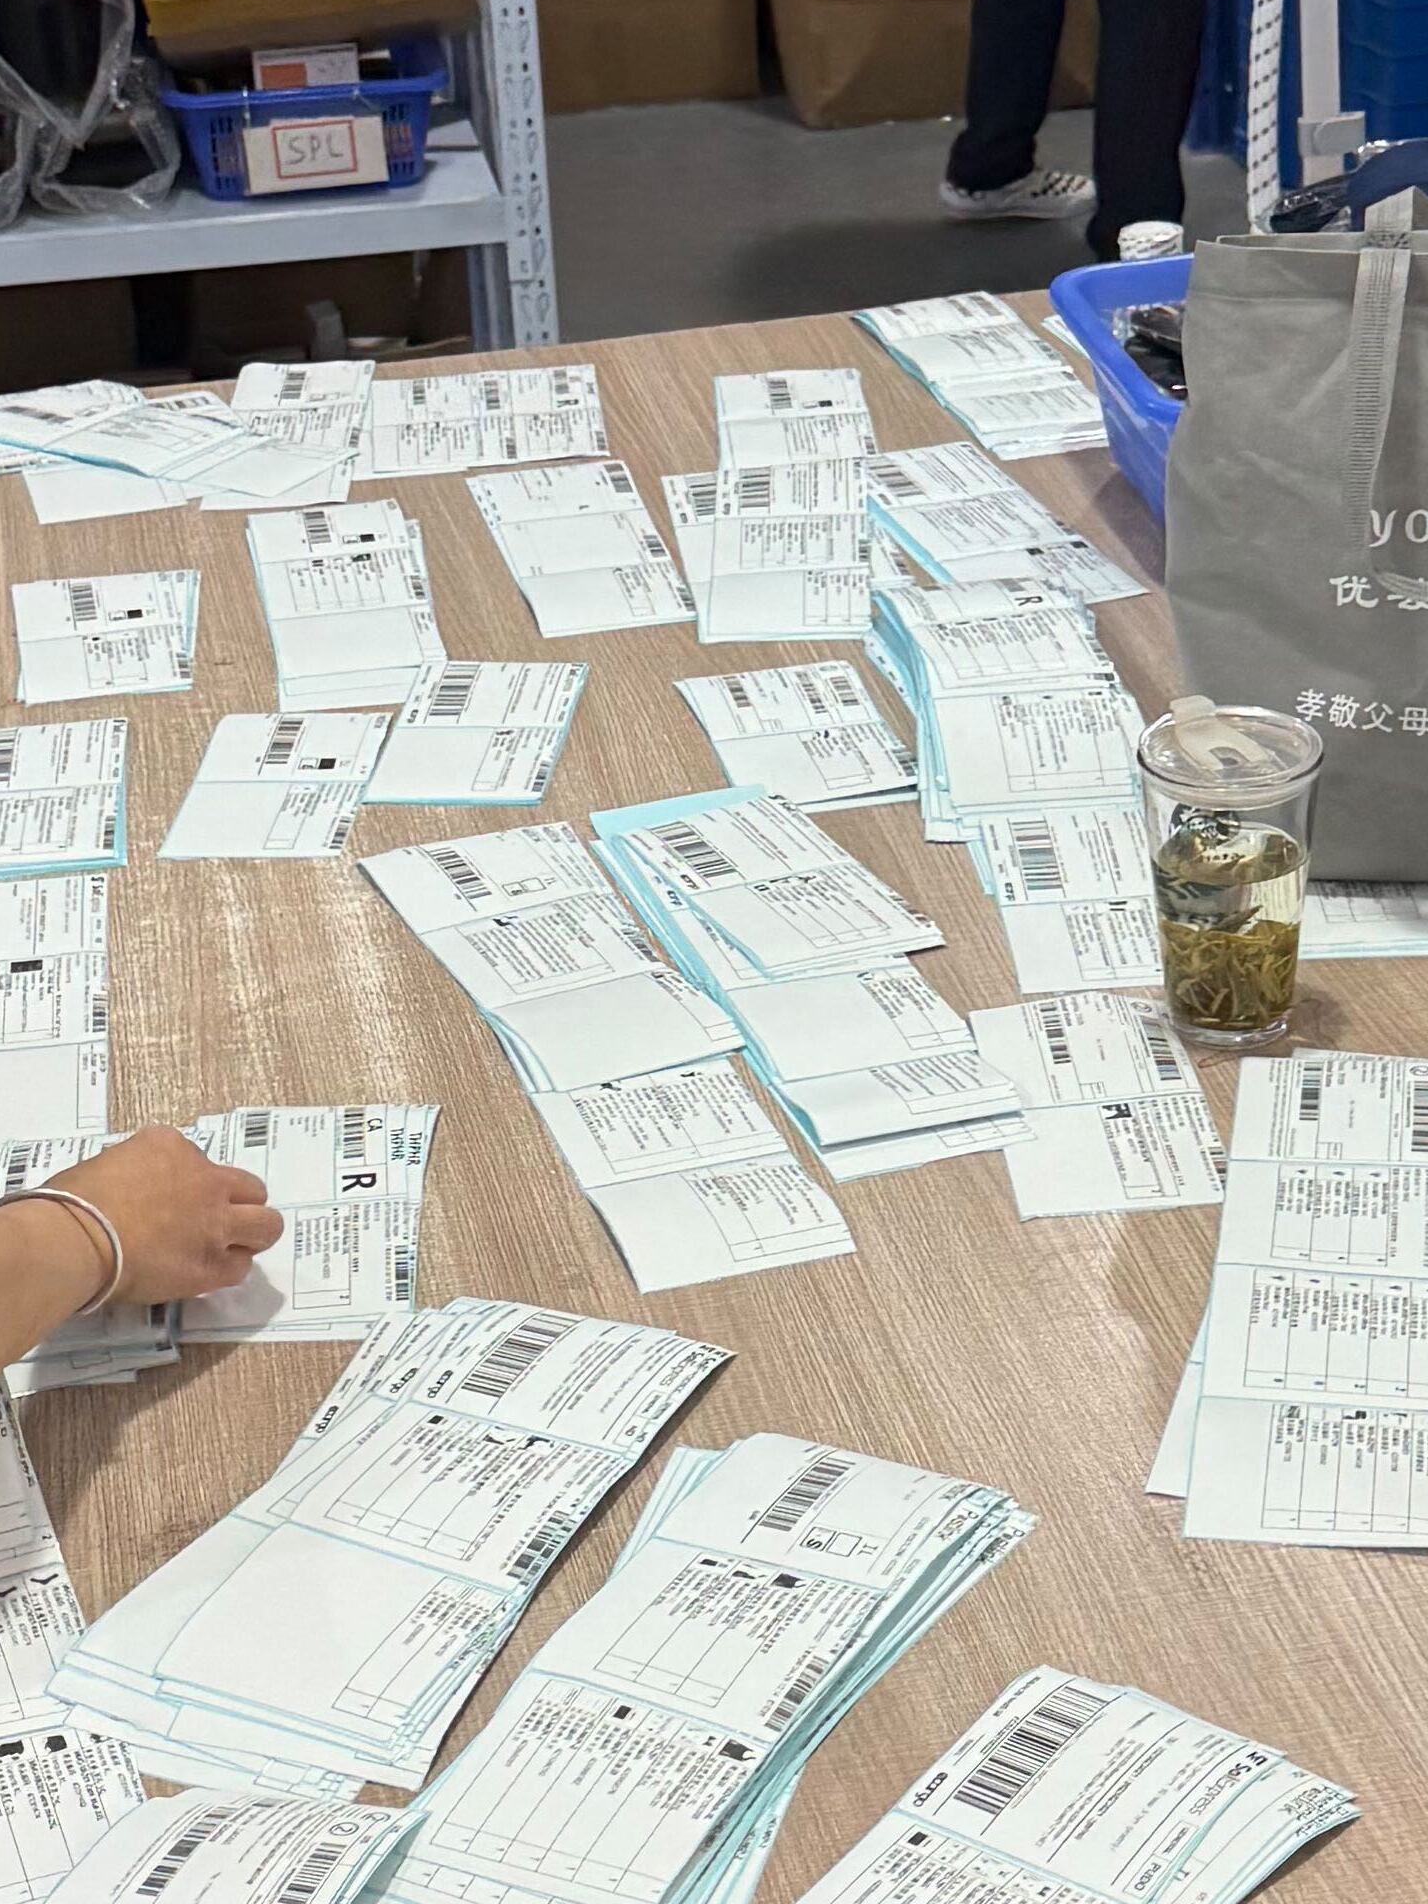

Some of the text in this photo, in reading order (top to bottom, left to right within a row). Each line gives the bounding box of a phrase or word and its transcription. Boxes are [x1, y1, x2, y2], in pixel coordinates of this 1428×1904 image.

[285, 133, 344, 165] SPL
[367, 1117, 384, 1133] CA
[341, 1172, 377, 1193] R
